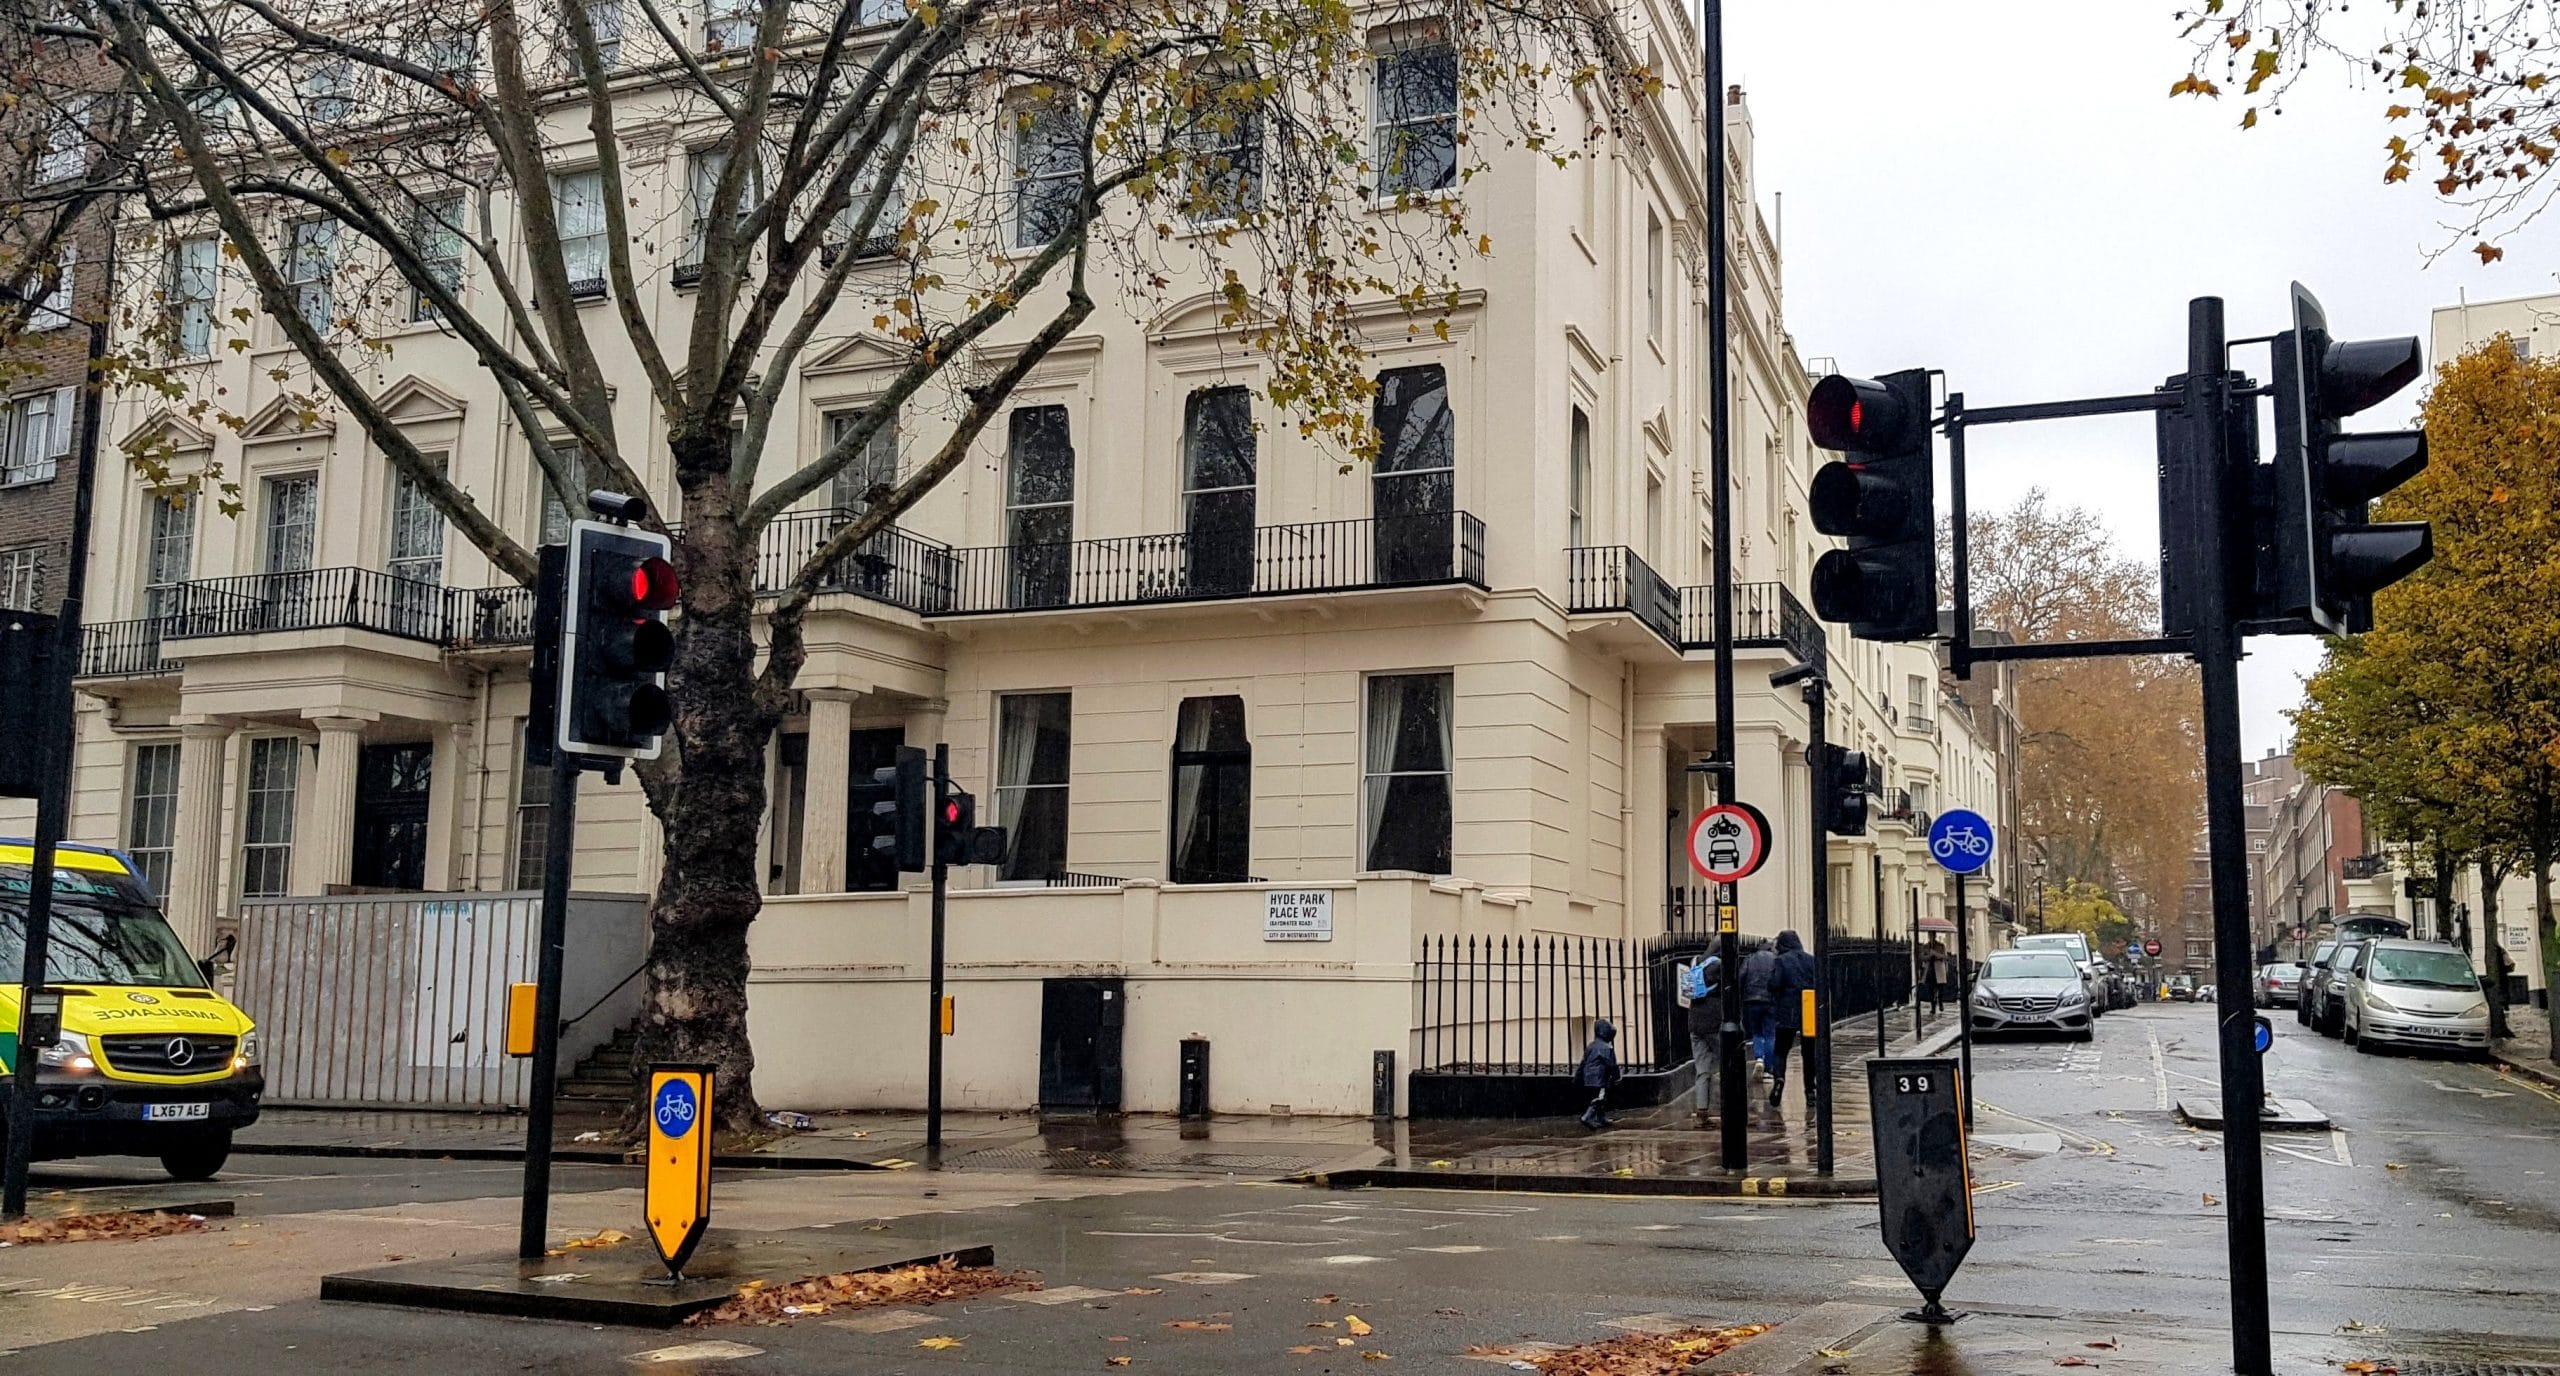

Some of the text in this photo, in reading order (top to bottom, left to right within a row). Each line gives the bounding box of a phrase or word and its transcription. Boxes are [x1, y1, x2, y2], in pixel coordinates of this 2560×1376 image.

[1270, 893, 1326, 905] HYDE PARK
[1269, 906, 1318, 918] PLACE W2
[152, 1104, 208, 1118] LX67 AEJ
